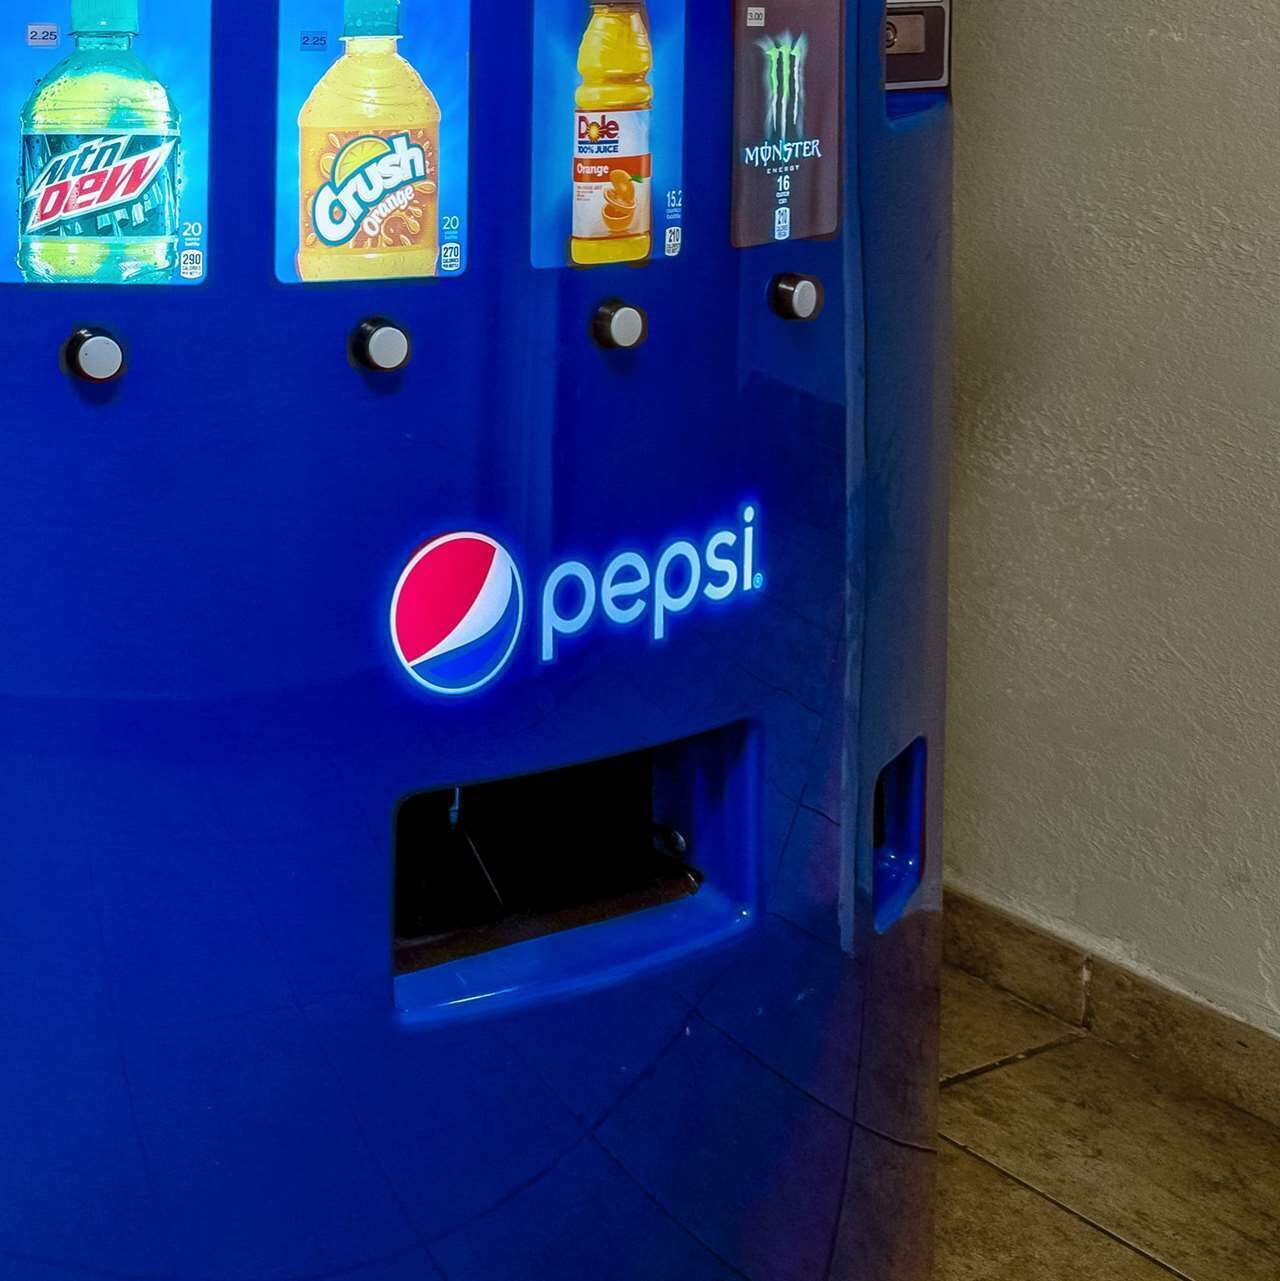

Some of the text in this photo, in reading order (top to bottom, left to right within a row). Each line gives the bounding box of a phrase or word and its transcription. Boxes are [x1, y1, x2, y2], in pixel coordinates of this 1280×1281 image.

[30, 31, 58, 41] 2.25
[302, 35, 327, 46] 2.25
[578, 114, 619, 141] Dole
[595, 145, 618, 154] JUICE
[745, 139, 822, 167] MONSTER
[576, 162, 609, 177] Orange
[314, 134, 426, 243] Crush
[776, 174, 790, 191] 16
[666, 190, 682, 207] 15.2
[182, 222, 202, 236] 20
[442, 215, 459, 230] 20
[182, 253, 201, 265] 290
[443, 246, 459, 258] 270
[541, 505, 754, 661] pepsi
